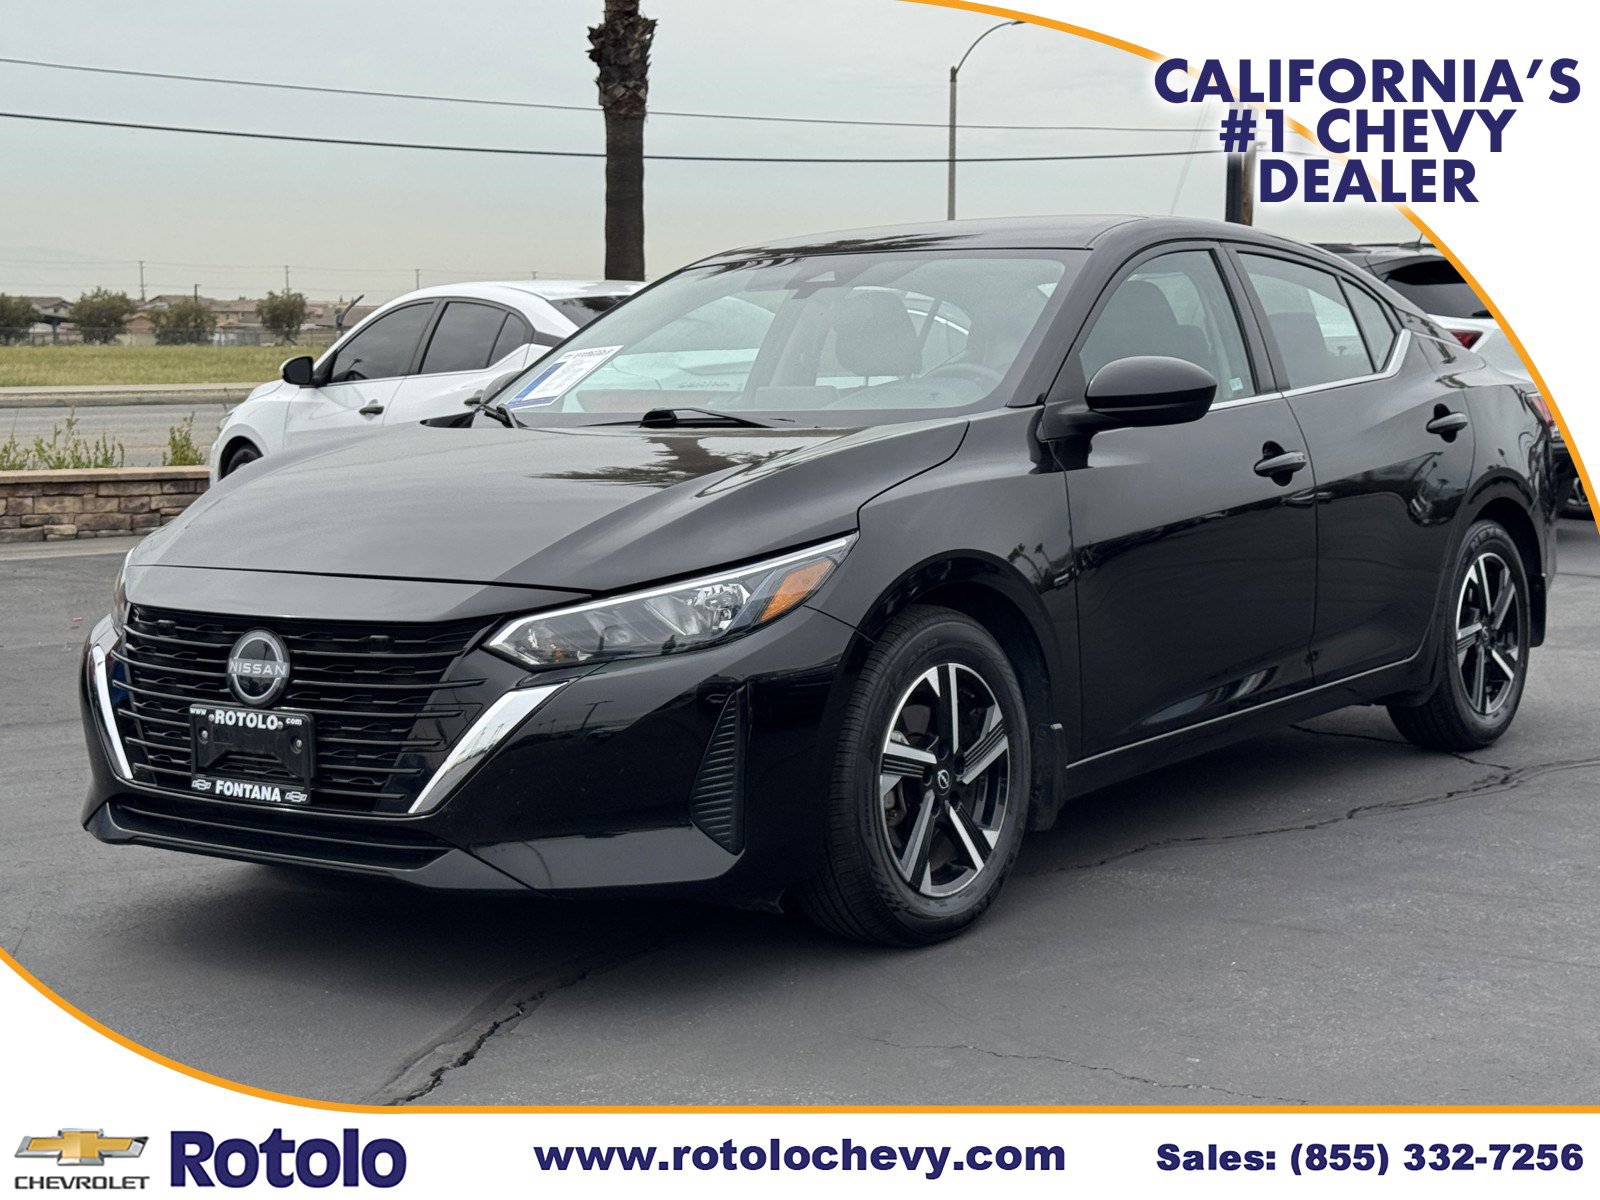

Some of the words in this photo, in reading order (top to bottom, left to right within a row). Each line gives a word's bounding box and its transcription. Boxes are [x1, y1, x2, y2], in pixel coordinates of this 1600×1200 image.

[228, 660, 287, 677] NISSAN
[189, 707, 207, 716] www
[214, 709, 278, 731] ROTOLO
[285, 717, 303, 726] com
[215, 780, 282, 802] FONTANA
